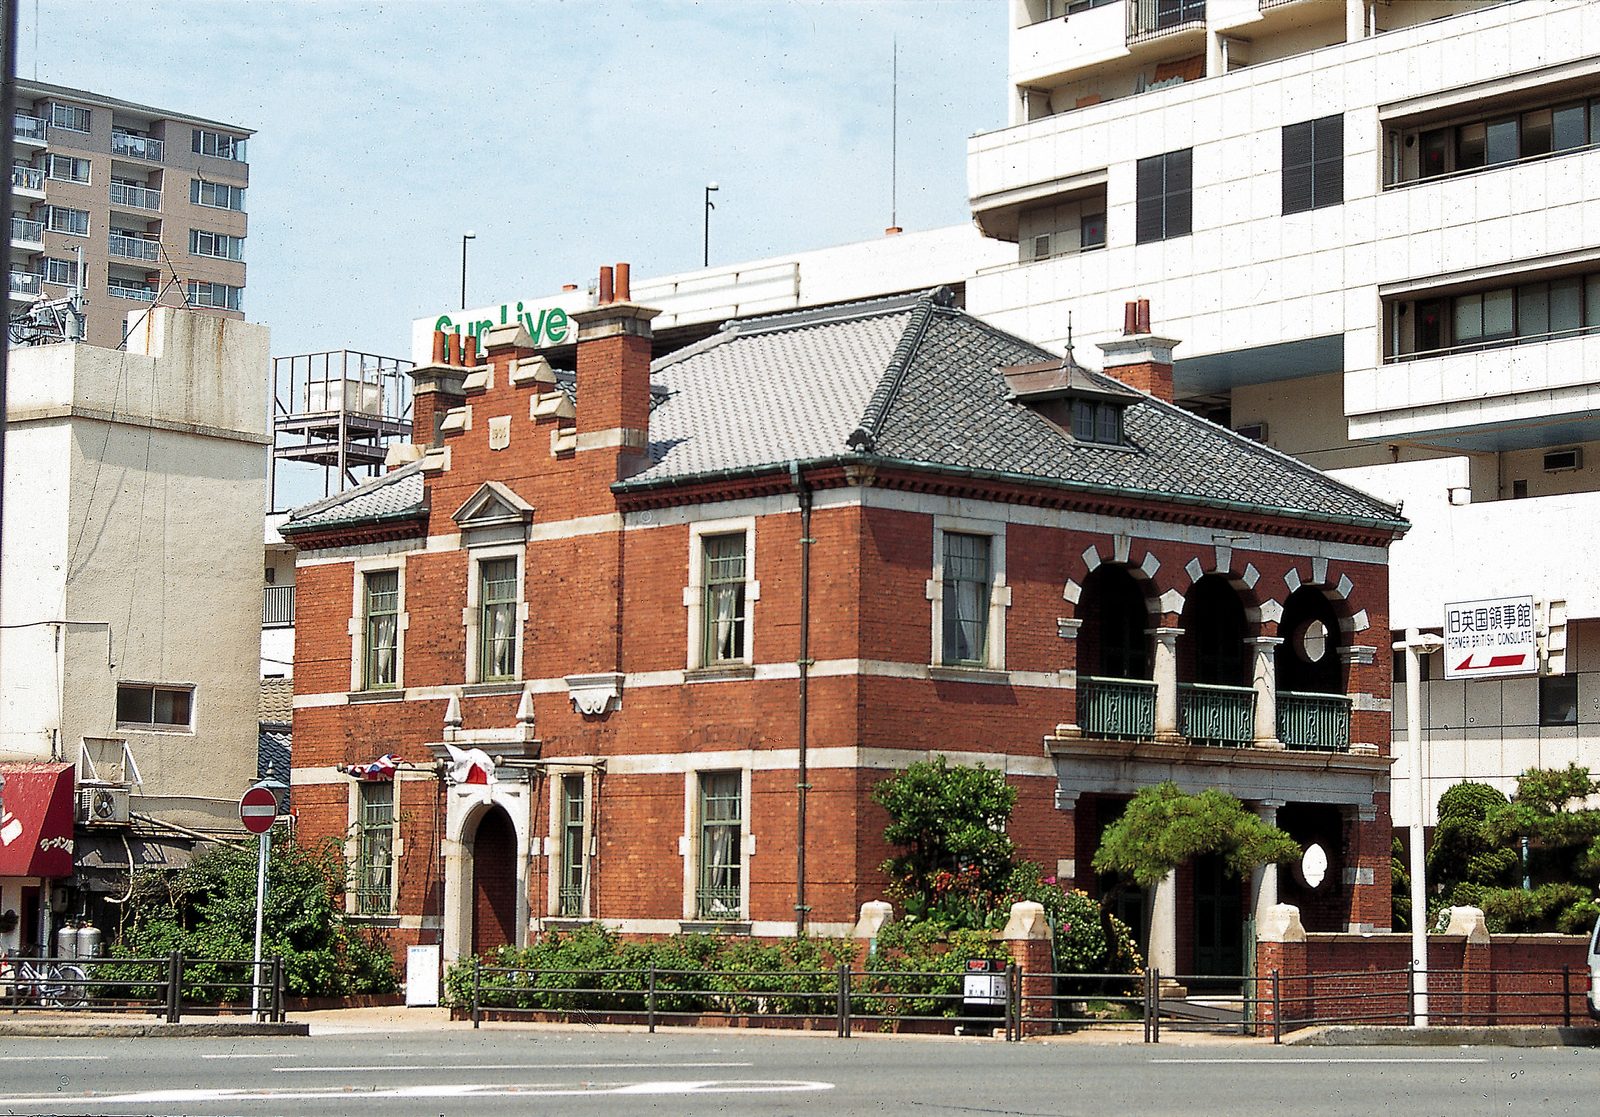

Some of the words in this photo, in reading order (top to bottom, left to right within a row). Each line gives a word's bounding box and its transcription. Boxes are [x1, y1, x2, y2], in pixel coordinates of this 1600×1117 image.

[1448, 603, 1531, 633] 旧英国領事館
[1448, 637, 1470, 650] FORMER
[1472, 633, 1495, 648] BRITISH
[1497, 630, 1532, 645] CONSULATE
